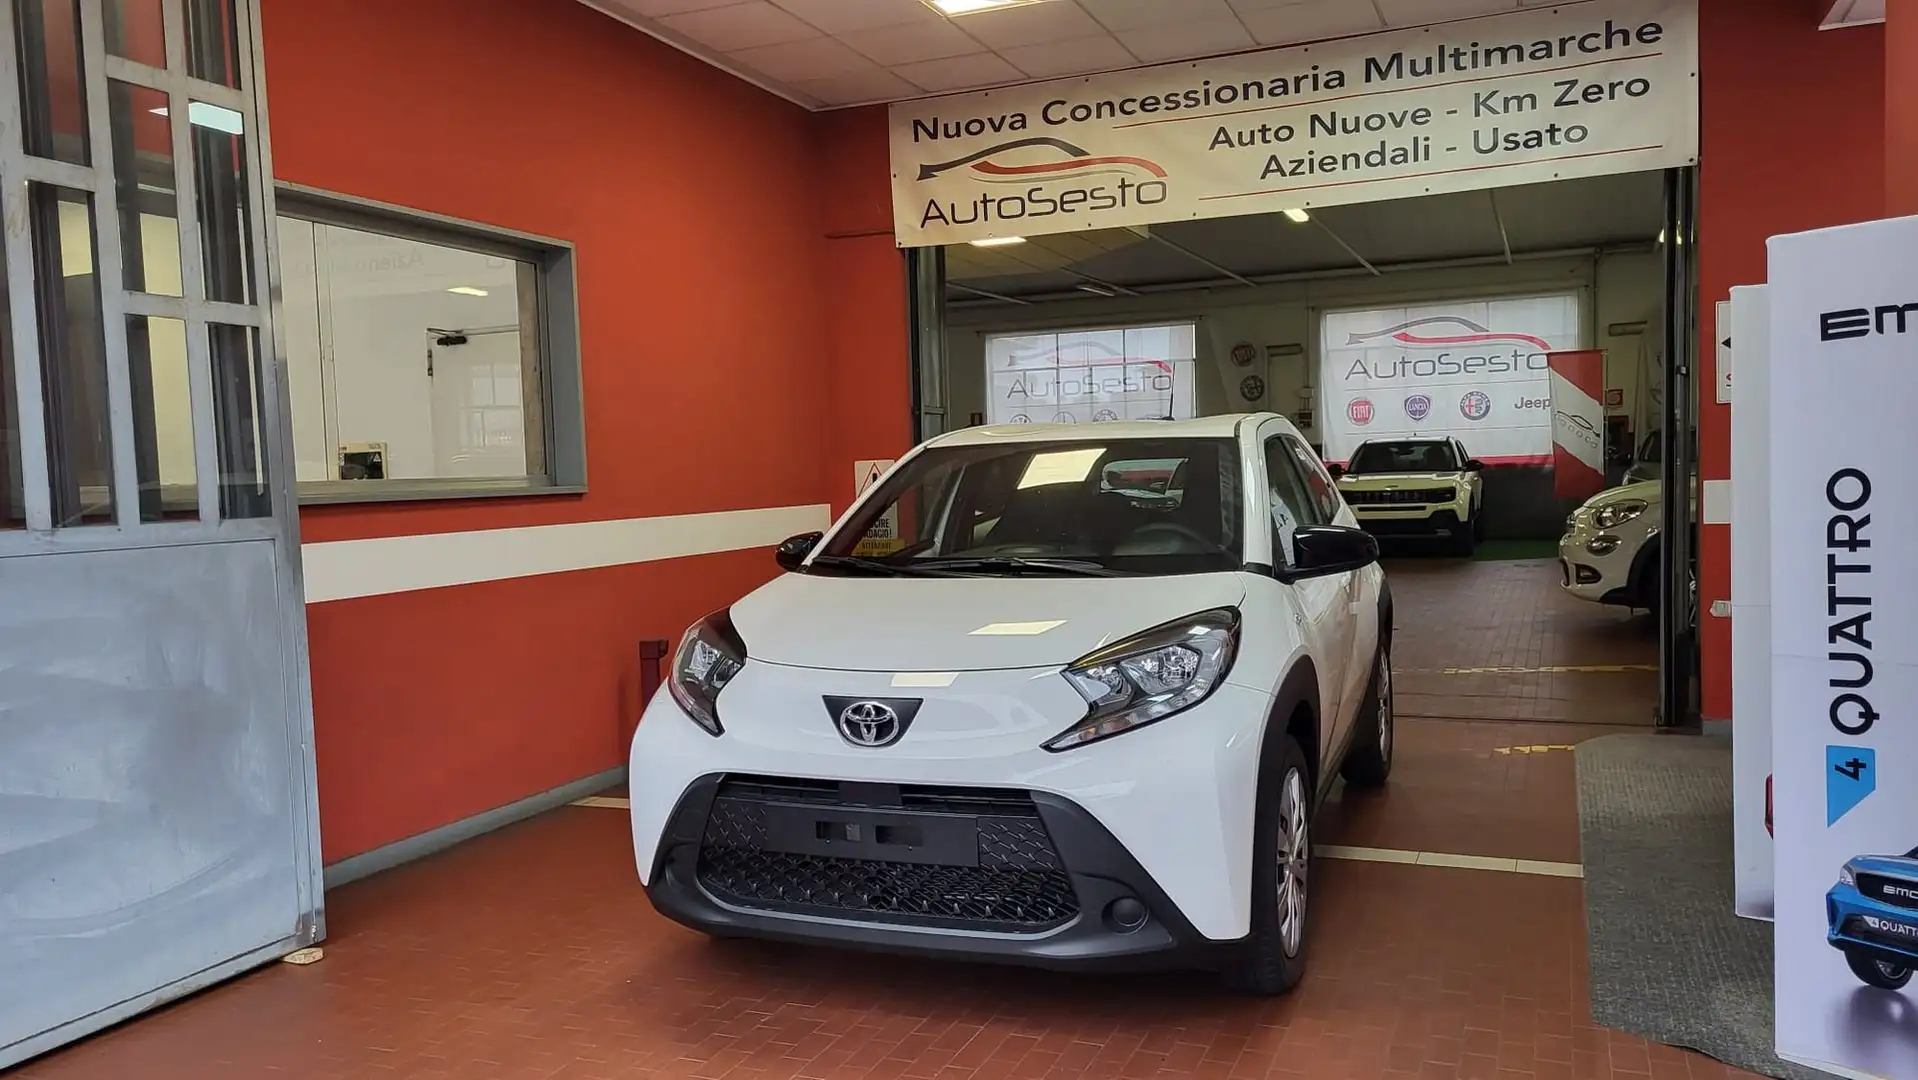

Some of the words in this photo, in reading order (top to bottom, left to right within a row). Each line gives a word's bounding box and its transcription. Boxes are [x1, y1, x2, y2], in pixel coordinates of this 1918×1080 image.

[912, 112, 1027, 142] Nuova
[1041, 64, 1345, 125] Concessionaria
[1364, 20, 1663, 83] Multimarche
[1208, 123, 1294, 150] Auto
[1310, 107, 1431, 138] Nuove
[1474, 90, 1537, 117] Km
[1553, 78, 1650, 107] Zero
[1260, 136, 1430, 180] Aziendali
[1473, 124, 1588, 154] Usato
[920, 177, 1167, 228] AutoSesto
[1007, 371, 1172, 399] AutoSesto
[1345, 350, 1549, 380] AutoSesto
[1514, 397, 1551, 410] Jeep
[1826, 468, 1880, 736] QUATTRO
[1834, 757, 1867, 782] 4
[1880, 920, 1918, 937] QUATT
